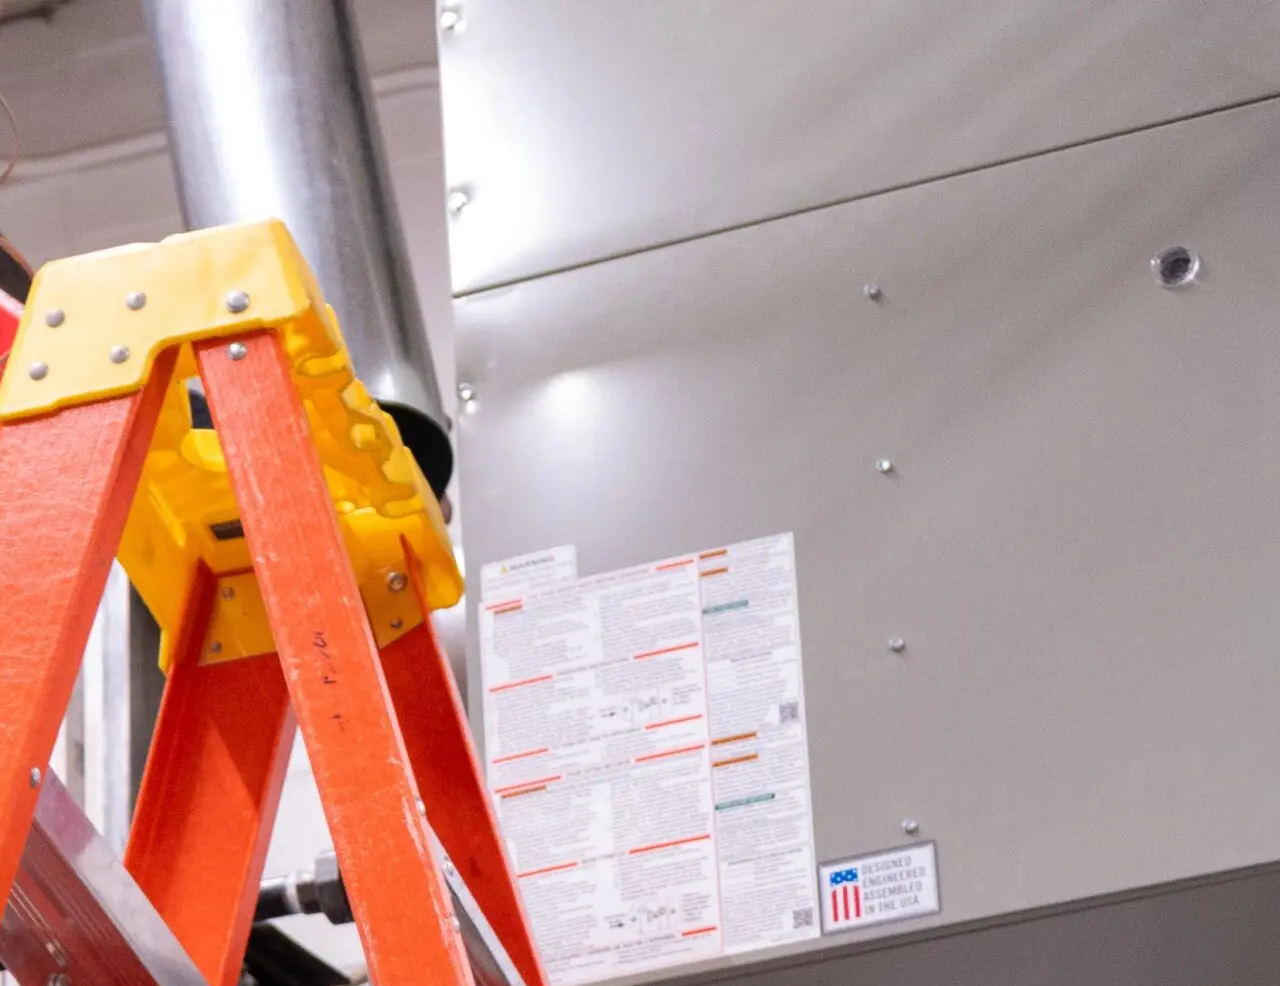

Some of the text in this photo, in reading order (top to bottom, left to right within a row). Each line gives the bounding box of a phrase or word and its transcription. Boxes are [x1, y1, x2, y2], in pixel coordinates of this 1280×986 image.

[861, 855, 912, 875] DESIGNED
[862, 866, 926, 888] ENGINEERED
[864, 881, 923, 901] ASSEMBLED
[865, 894, 920, 915] IN THE USA
